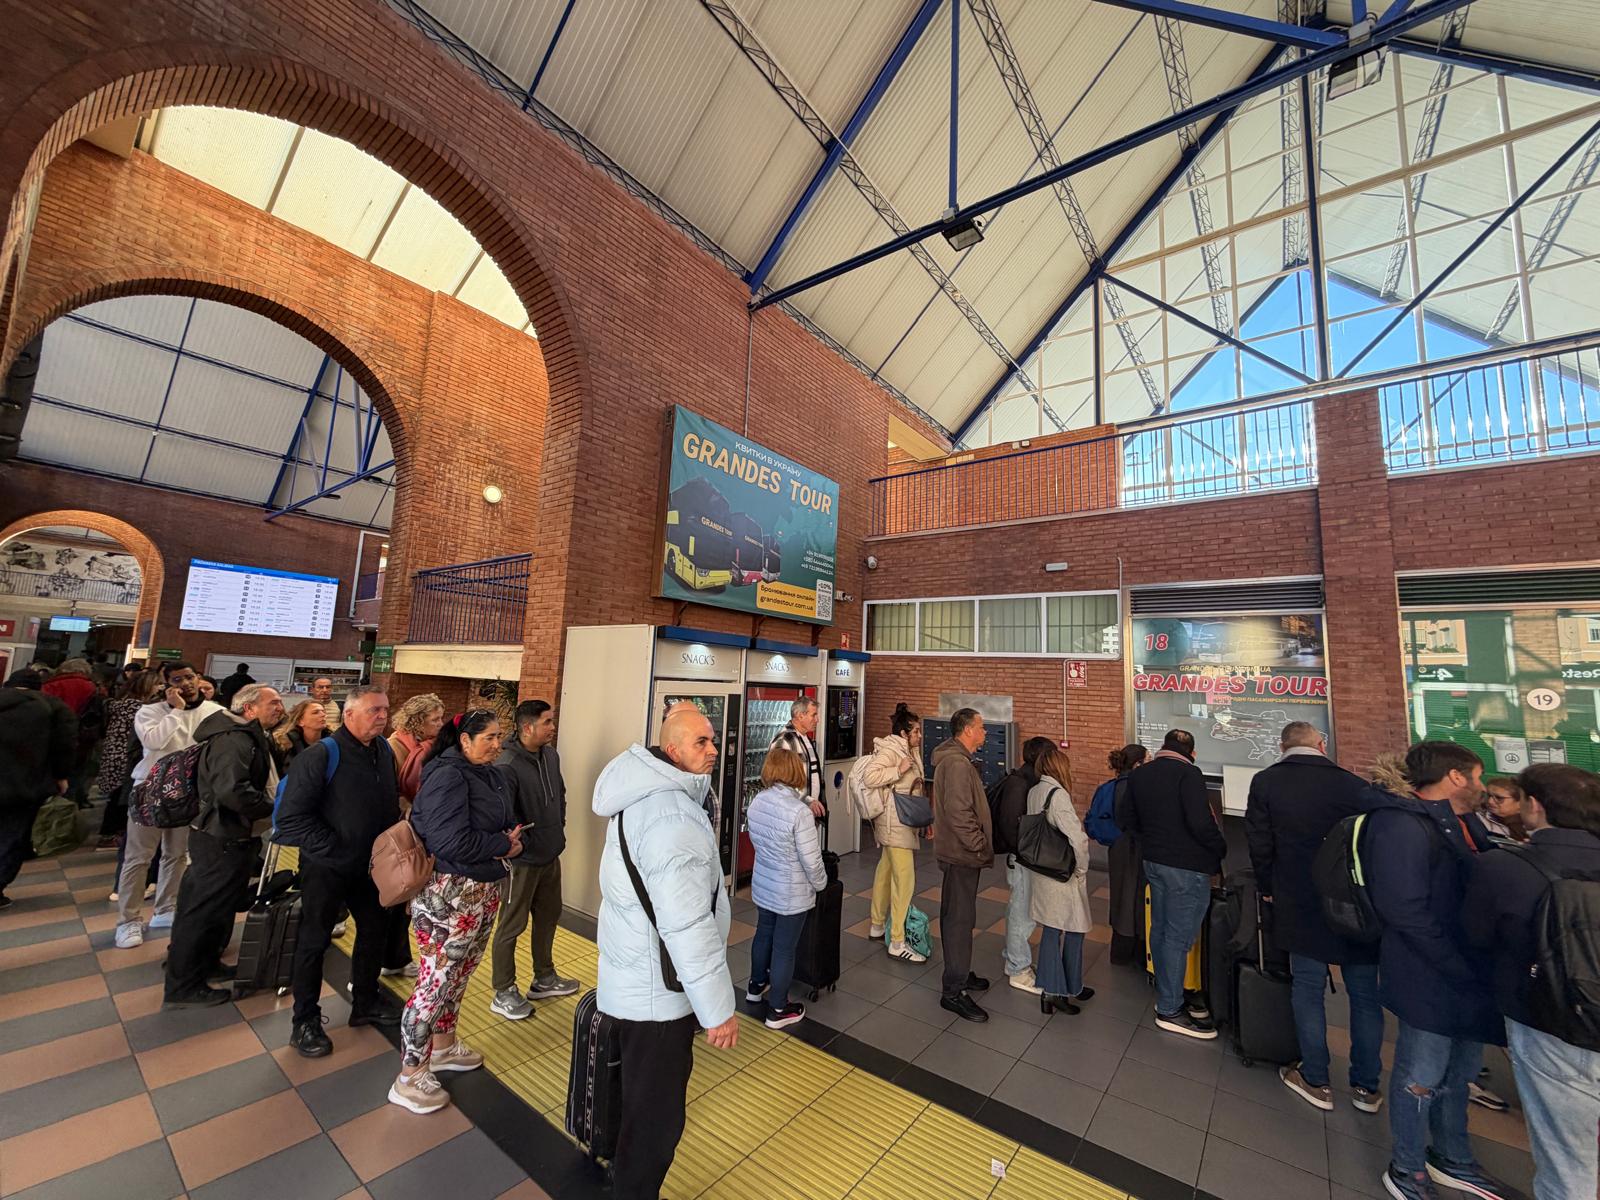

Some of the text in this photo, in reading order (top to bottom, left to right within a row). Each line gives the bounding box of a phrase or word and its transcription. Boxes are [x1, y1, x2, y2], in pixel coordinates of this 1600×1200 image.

[735, 441, 802, 477] КВИТКИ В УКРАЇНУ
[683, 433, 832, 515] GRANDES TOUR
[702, 516, 724, 533] GRANDES
[1144, 633, 1169, 651] 18
[681, 652, 715, 666] SNACK'S
[835, 667, 850, 676] CAFÉ
[1133, 673, 1328, 697] GRANDES TOUR
[1534, 694, 1553, 705] 19
